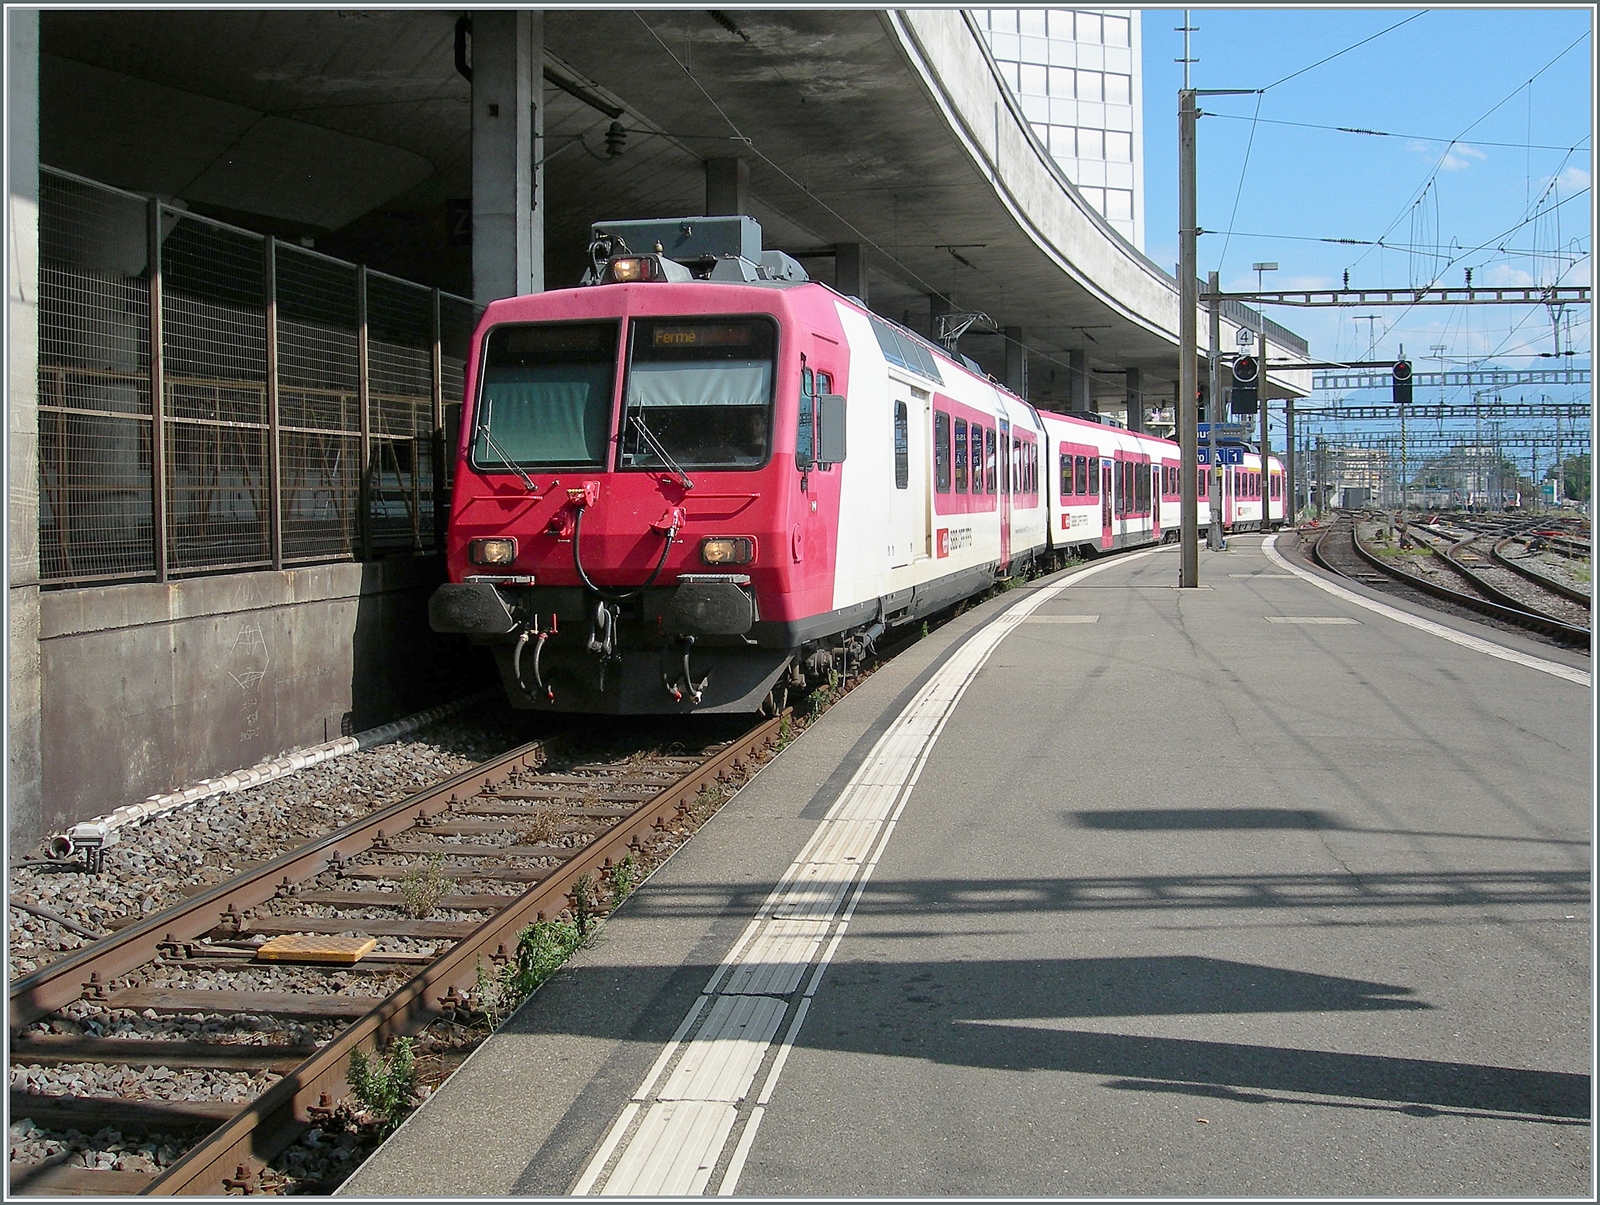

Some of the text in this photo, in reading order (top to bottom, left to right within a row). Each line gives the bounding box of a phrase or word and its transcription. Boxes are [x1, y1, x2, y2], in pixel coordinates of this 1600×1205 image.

[1240, 331, 1249, 343] 4
[1232, 453, 1237, 462] 1
[950, 529, 958, 551] SBB
